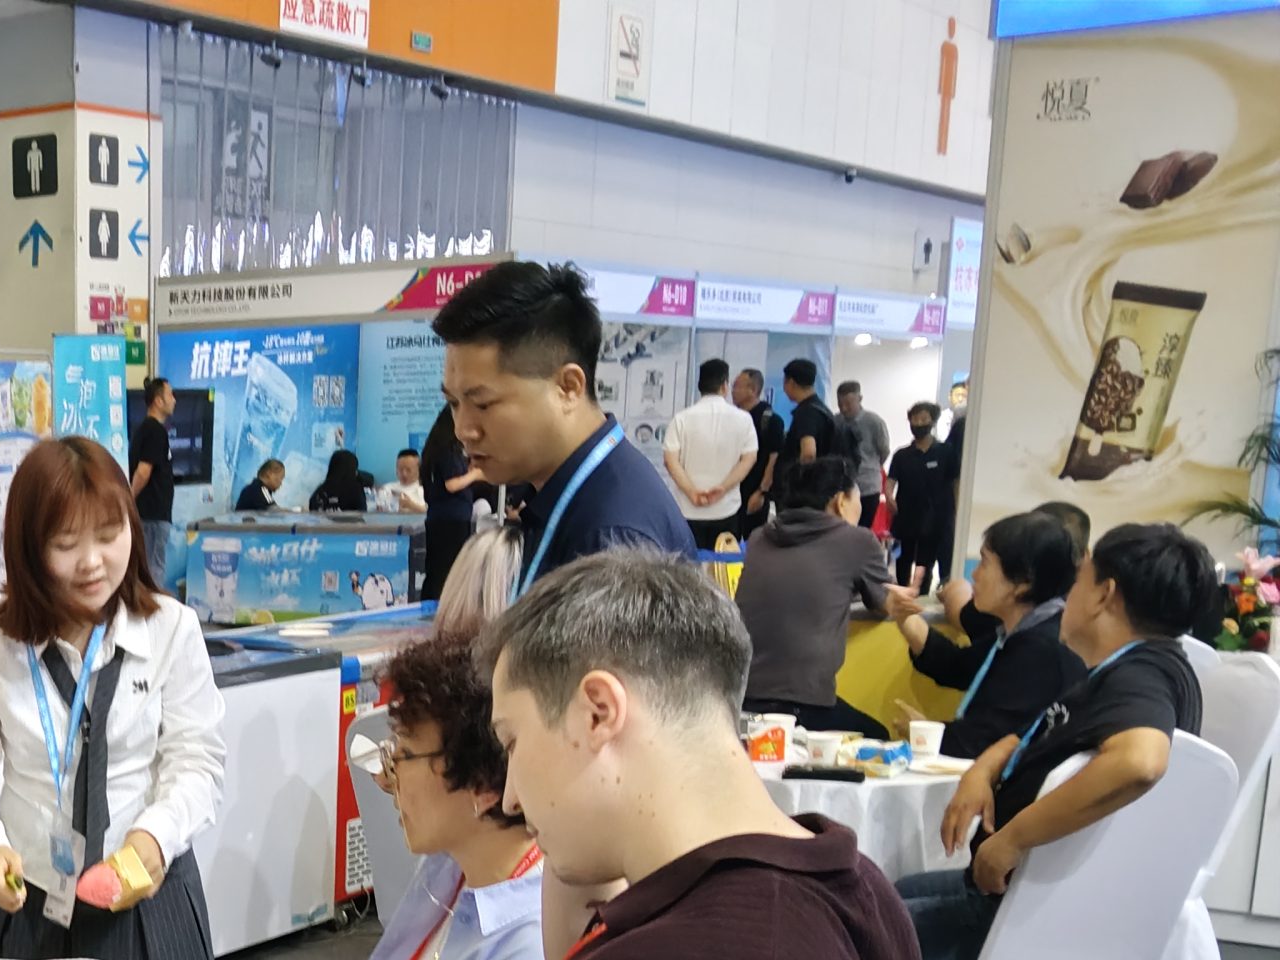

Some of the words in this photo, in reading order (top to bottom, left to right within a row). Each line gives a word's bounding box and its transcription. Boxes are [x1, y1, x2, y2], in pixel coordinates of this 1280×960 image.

[282, 0, 368, 38] 应急疏散门
[436, 271, 482, 296] N6-D
